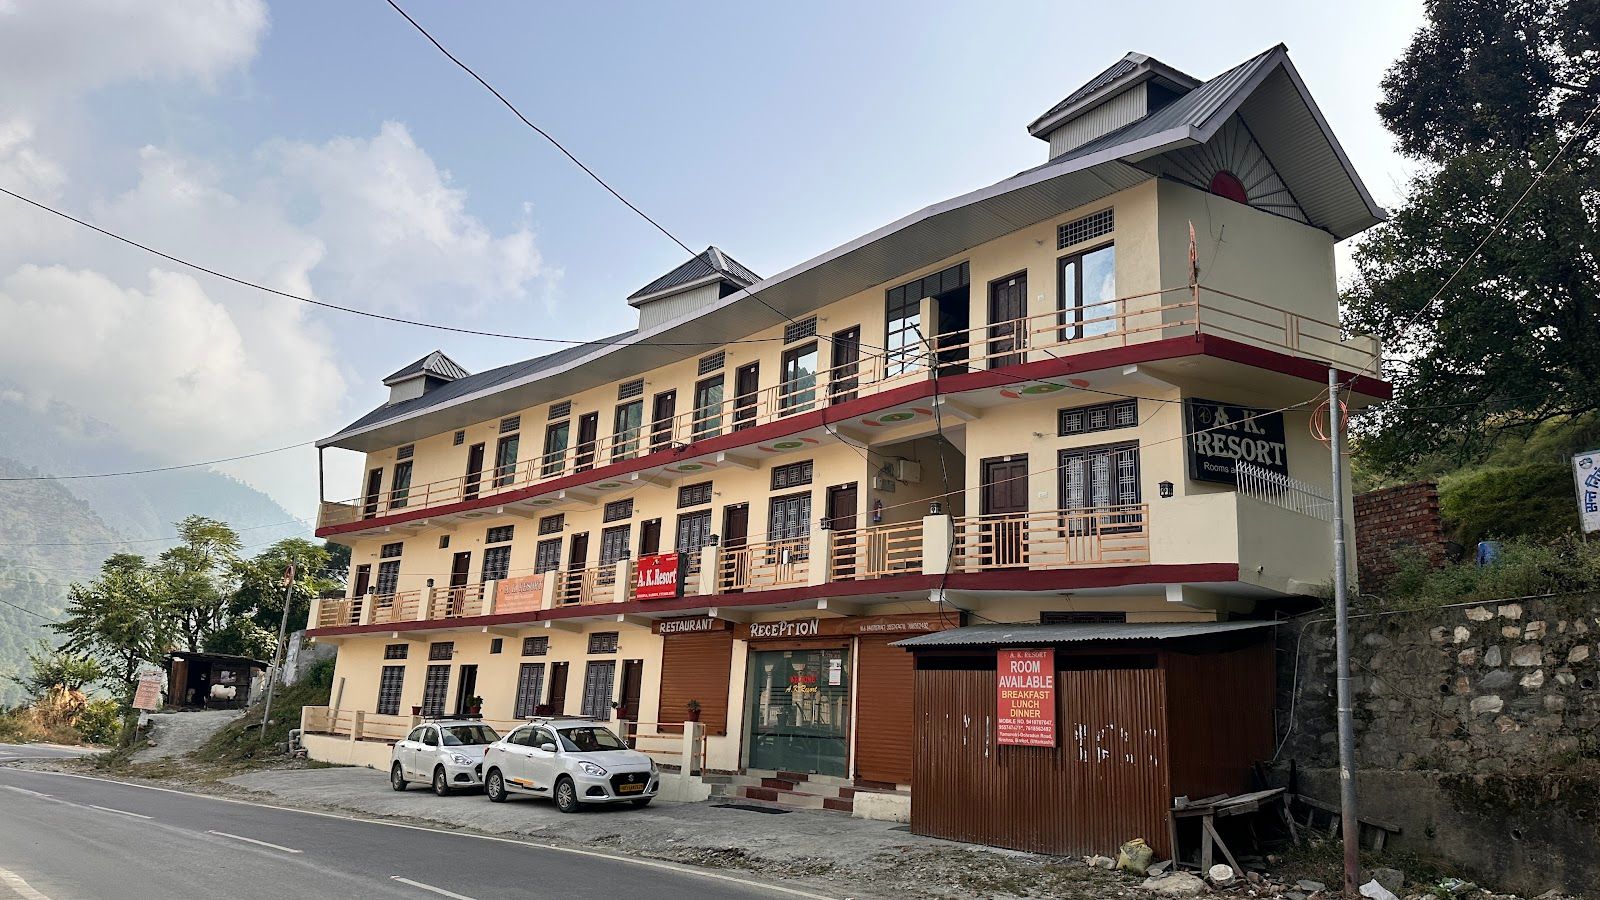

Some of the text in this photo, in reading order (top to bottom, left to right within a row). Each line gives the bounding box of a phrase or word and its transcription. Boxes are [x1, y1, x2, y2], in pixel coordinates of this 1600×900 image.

[1196, 431, 1285, 466] RESORT
[1203, 461, 1230, 474] Rooms
[659, 618, 714, 633] RESTAURANT
[750, 619, 819, 637] RECEPTION
[1010, 660, 1041, 673] ROOM
[999, 675, 1053, 689] AVAILABLE
[1001, 690, 1050, 699] BREAKFAST
[1011, 700, 1040, 709] LUNCH
[1010, 709, 1041, 718] DINNER
